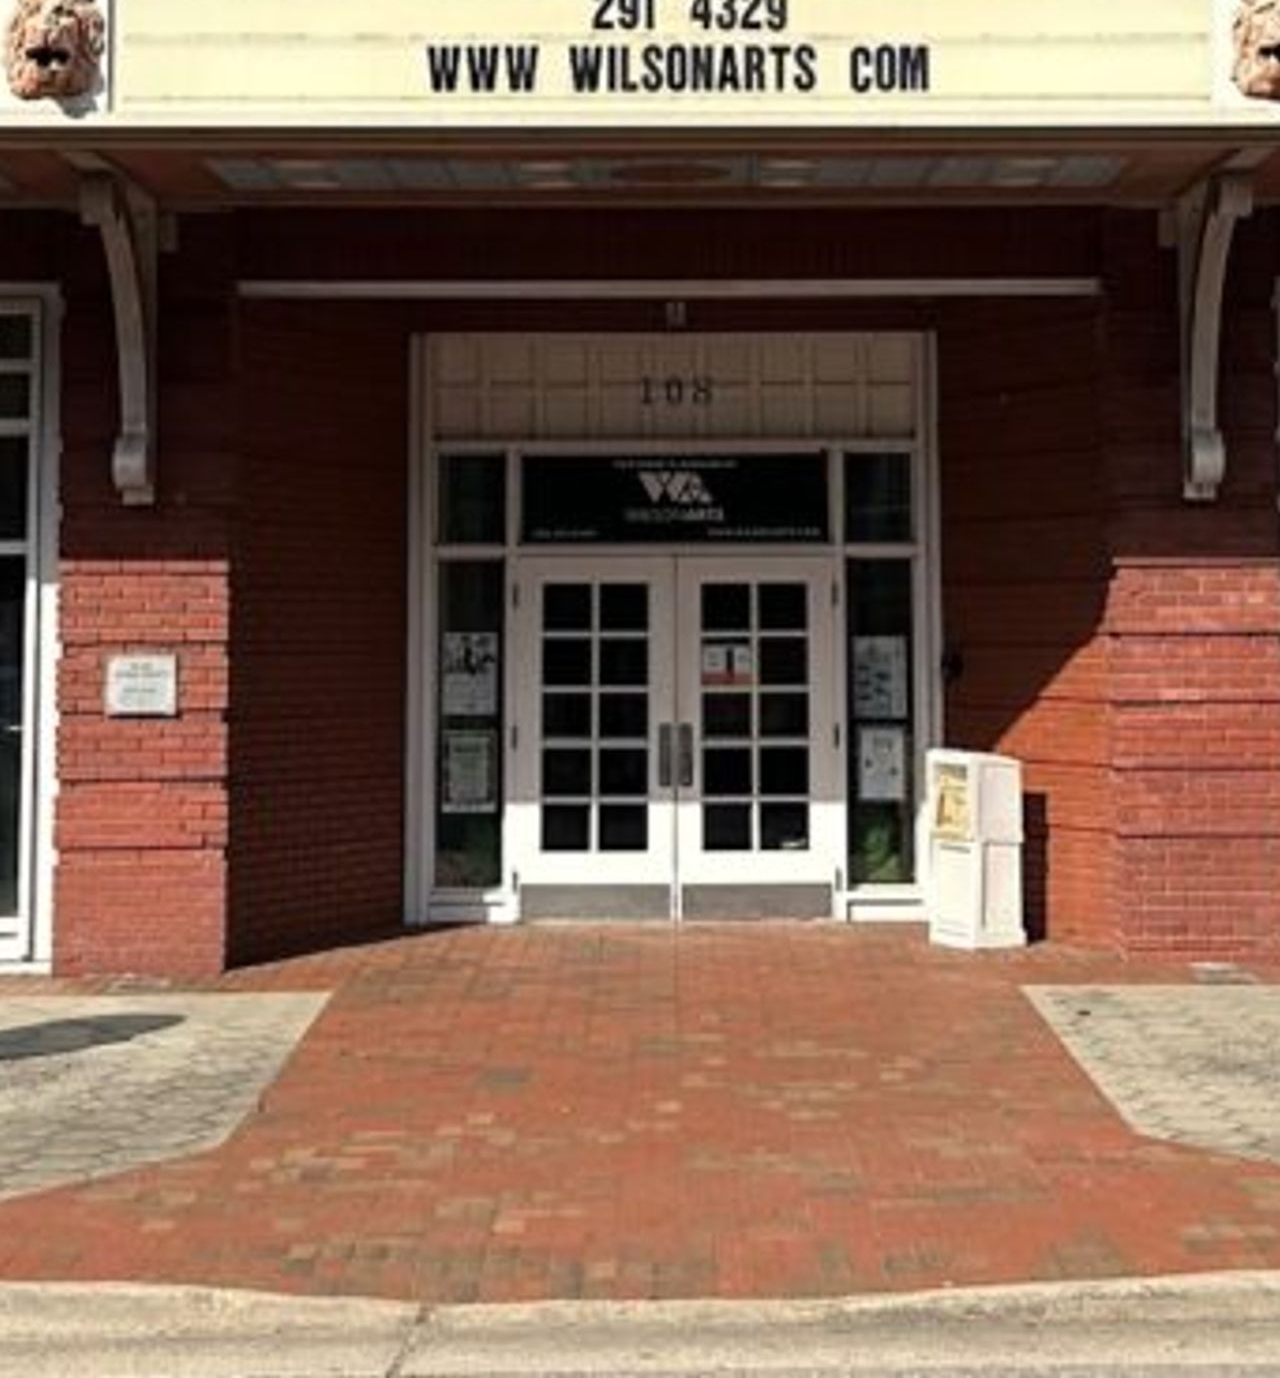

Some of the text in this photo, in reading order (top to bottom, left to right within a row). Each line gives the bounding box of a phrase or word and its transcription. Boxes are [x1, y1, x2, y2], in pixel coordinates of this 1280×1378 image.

[427, 44, 929, 94] WWW WILSONARTS COM
[638, 375, 715, 407] 108
